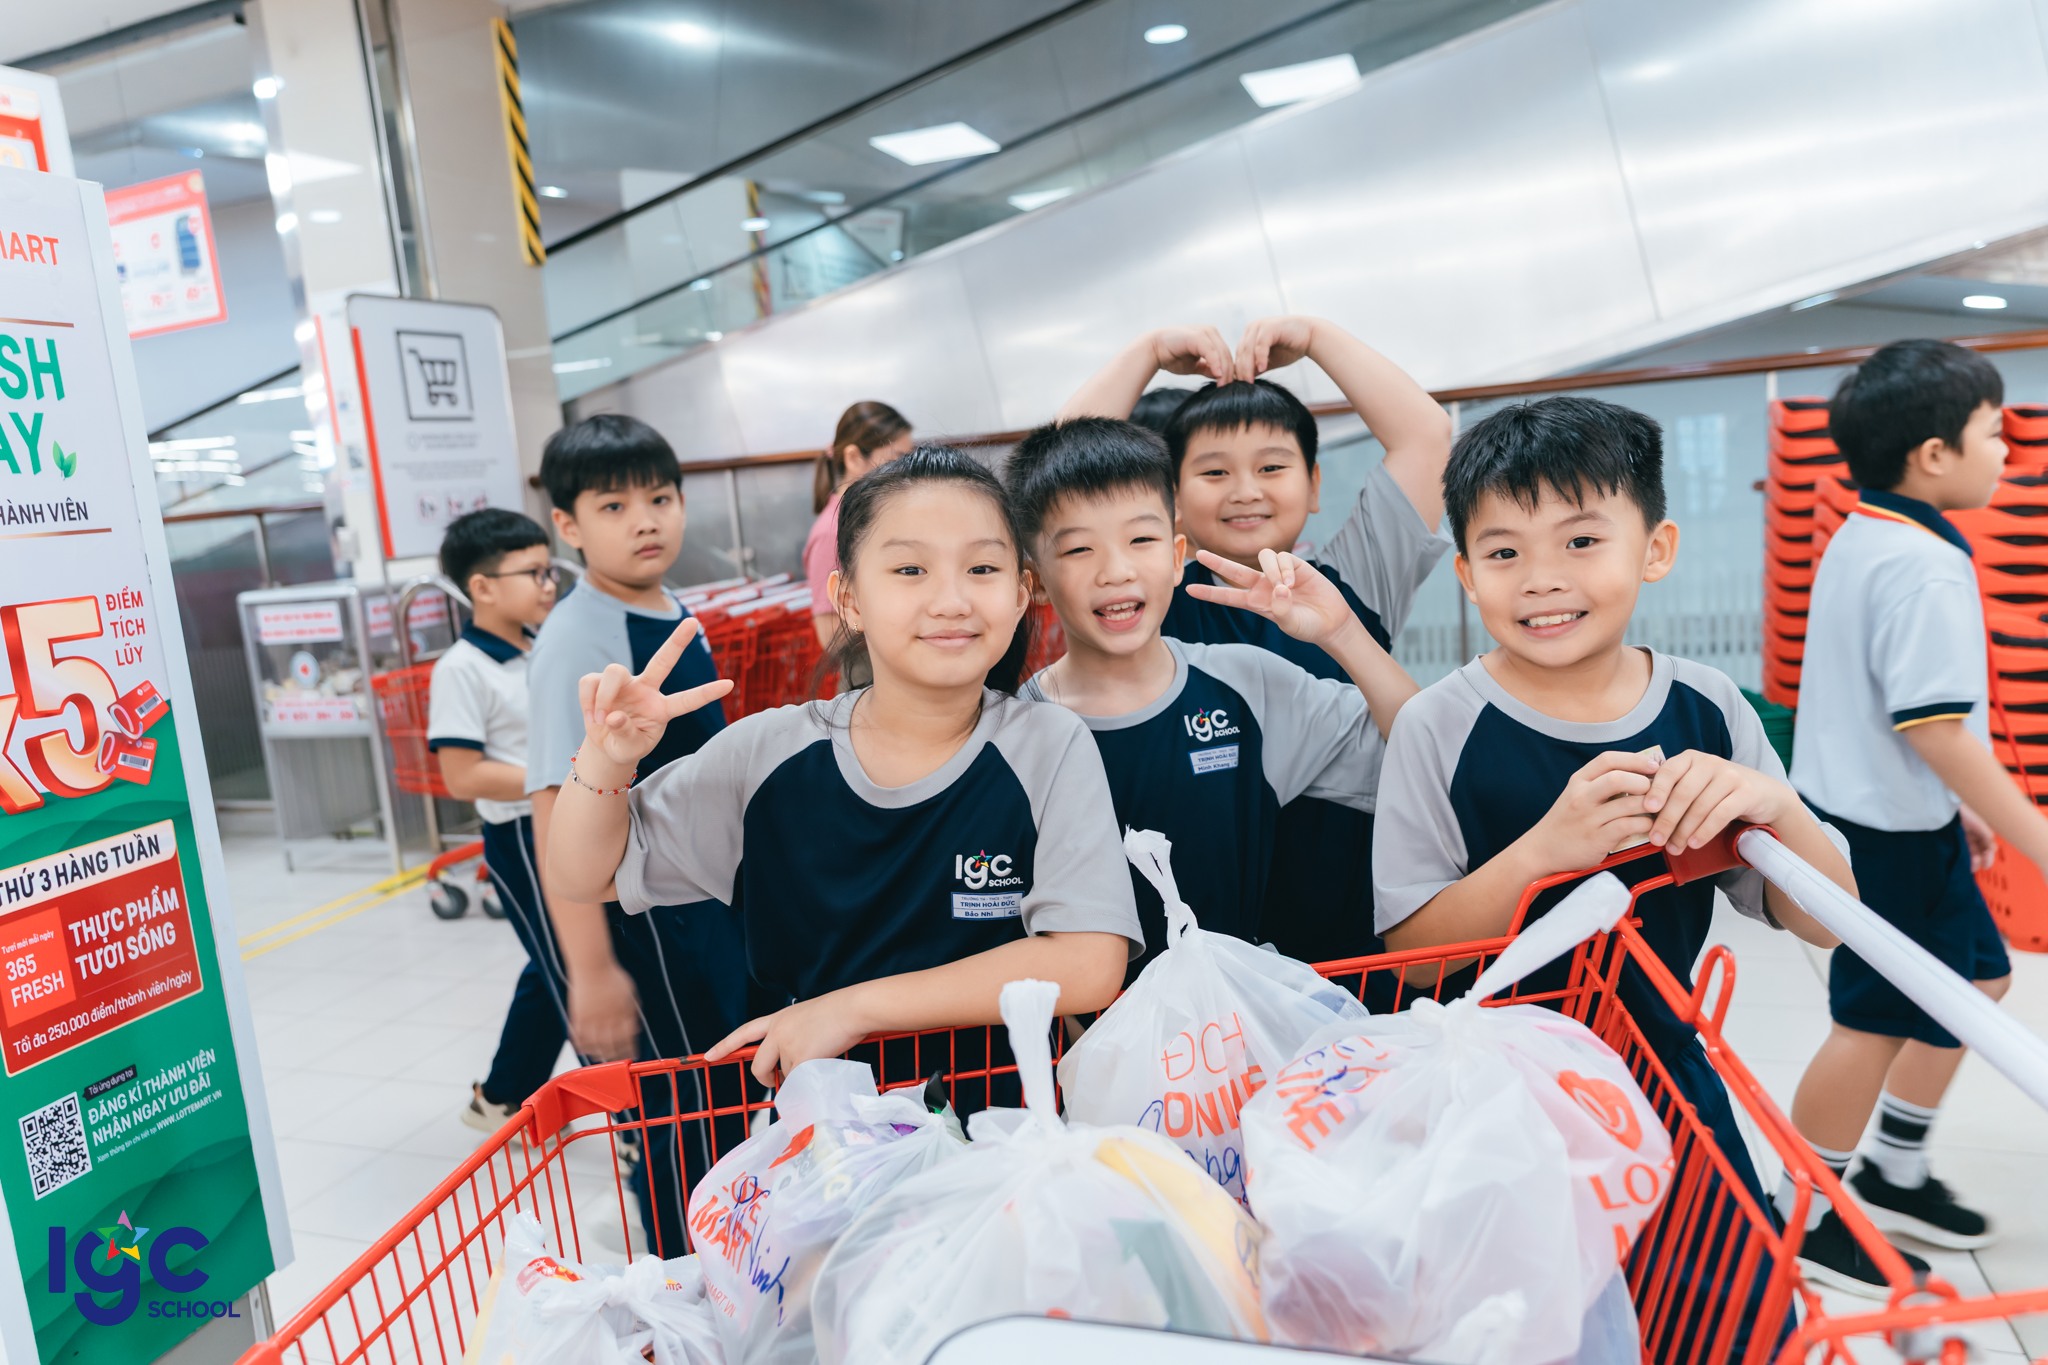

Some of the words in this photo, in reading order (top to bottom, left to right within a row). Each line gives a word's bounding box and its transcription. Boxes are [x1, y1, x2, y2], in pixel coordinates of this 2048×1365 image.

[47, 497, 89, 522] VIÊN
[106, 586, 144, 611] ĐIỂM
[110, 615, 146, 639] TÍCH
[115, 643, 144, 667] LŨY
[1214, 726, 1240, 738] SCHOOL
[39, 868, 51, 892] 3
[54, 853, 109, 888] HÀNG
[110, 833, 161, 868] TUẦN
[988, 877, 1023, 888] SCHOOL
[68, 907, 125, 947] THỰC
[125, 885, 180, 927] PHẨM
[5, 953, 37, 981] 365
[75, 946, 125, 980] TƯƠI
[127, 921, 177, 961] SỐNG
[10, 970, 65, 1008] FRESH
[32, 1033, 48, 1048] đa
[47, 1012, 90, 1042] 250,000
[90, 990, 146, 1023] điểm/thành
[147, 970, 192, 998] viên/ngày
[88, 1093, 128, 1125] ĐĂNG
[128, 1080, 142, 1104] KÍ
[142, 1068, 187, 1096] THÀNH
[187, 1048, 216, 1074] VIÊN
[92, 1113, 132, 1147] NHẬN
[132, 1094, 167, 1126] NGAY
[169, 1084, 188, 1106] ƯU
[189, 1072, 211, 1096] ĐÃI
